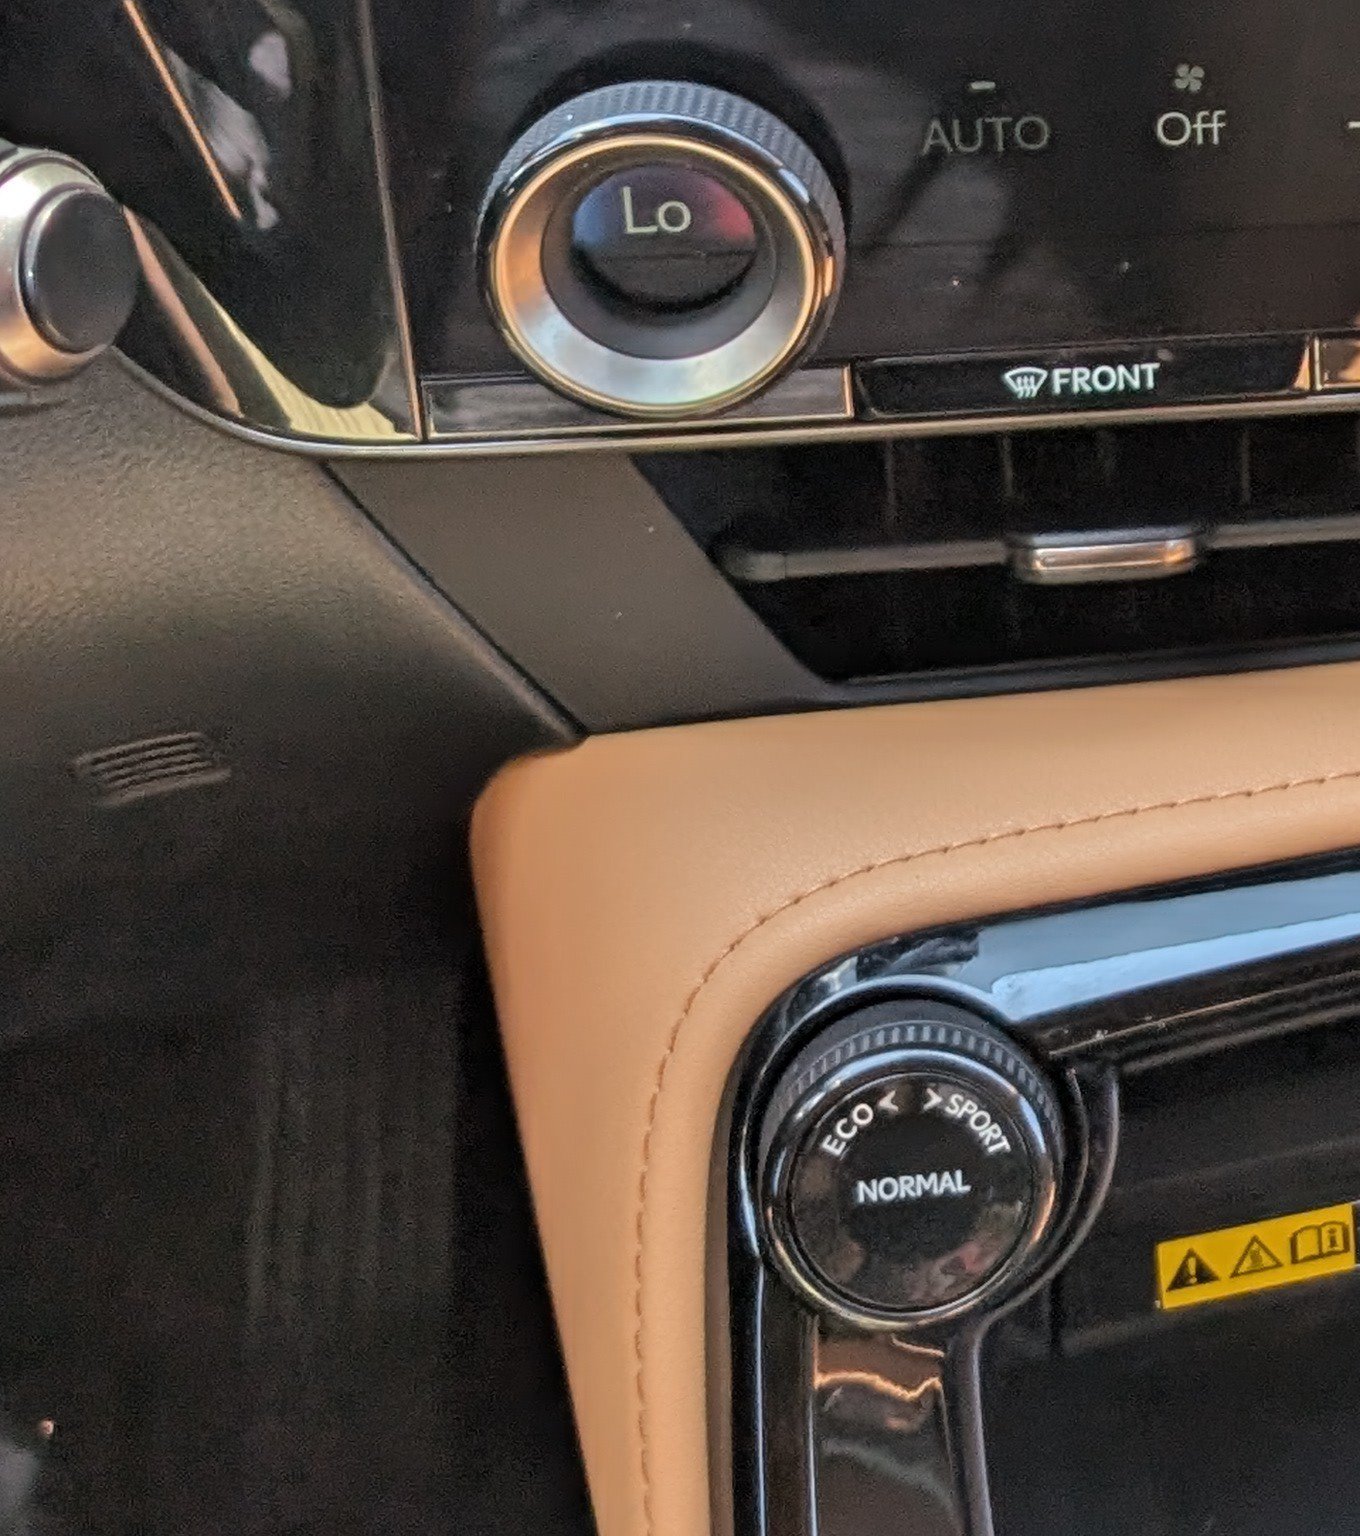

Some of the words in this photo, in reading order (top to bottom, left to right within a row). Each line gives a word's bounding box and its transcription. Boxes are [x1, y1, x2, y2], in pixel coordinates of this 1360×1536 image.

[921, 115, 1050, 156] AUTO
[1155, 109, 1227, 147] Off
[621, 185, 692, 235] Lo
[1051, 360, 1161, 396] FRONT
[820, 1102, 875, 1158] ECO
[944, 1092, 1012, 1155] SPORT
[855, 1168, 973, 1204] NORMAL
